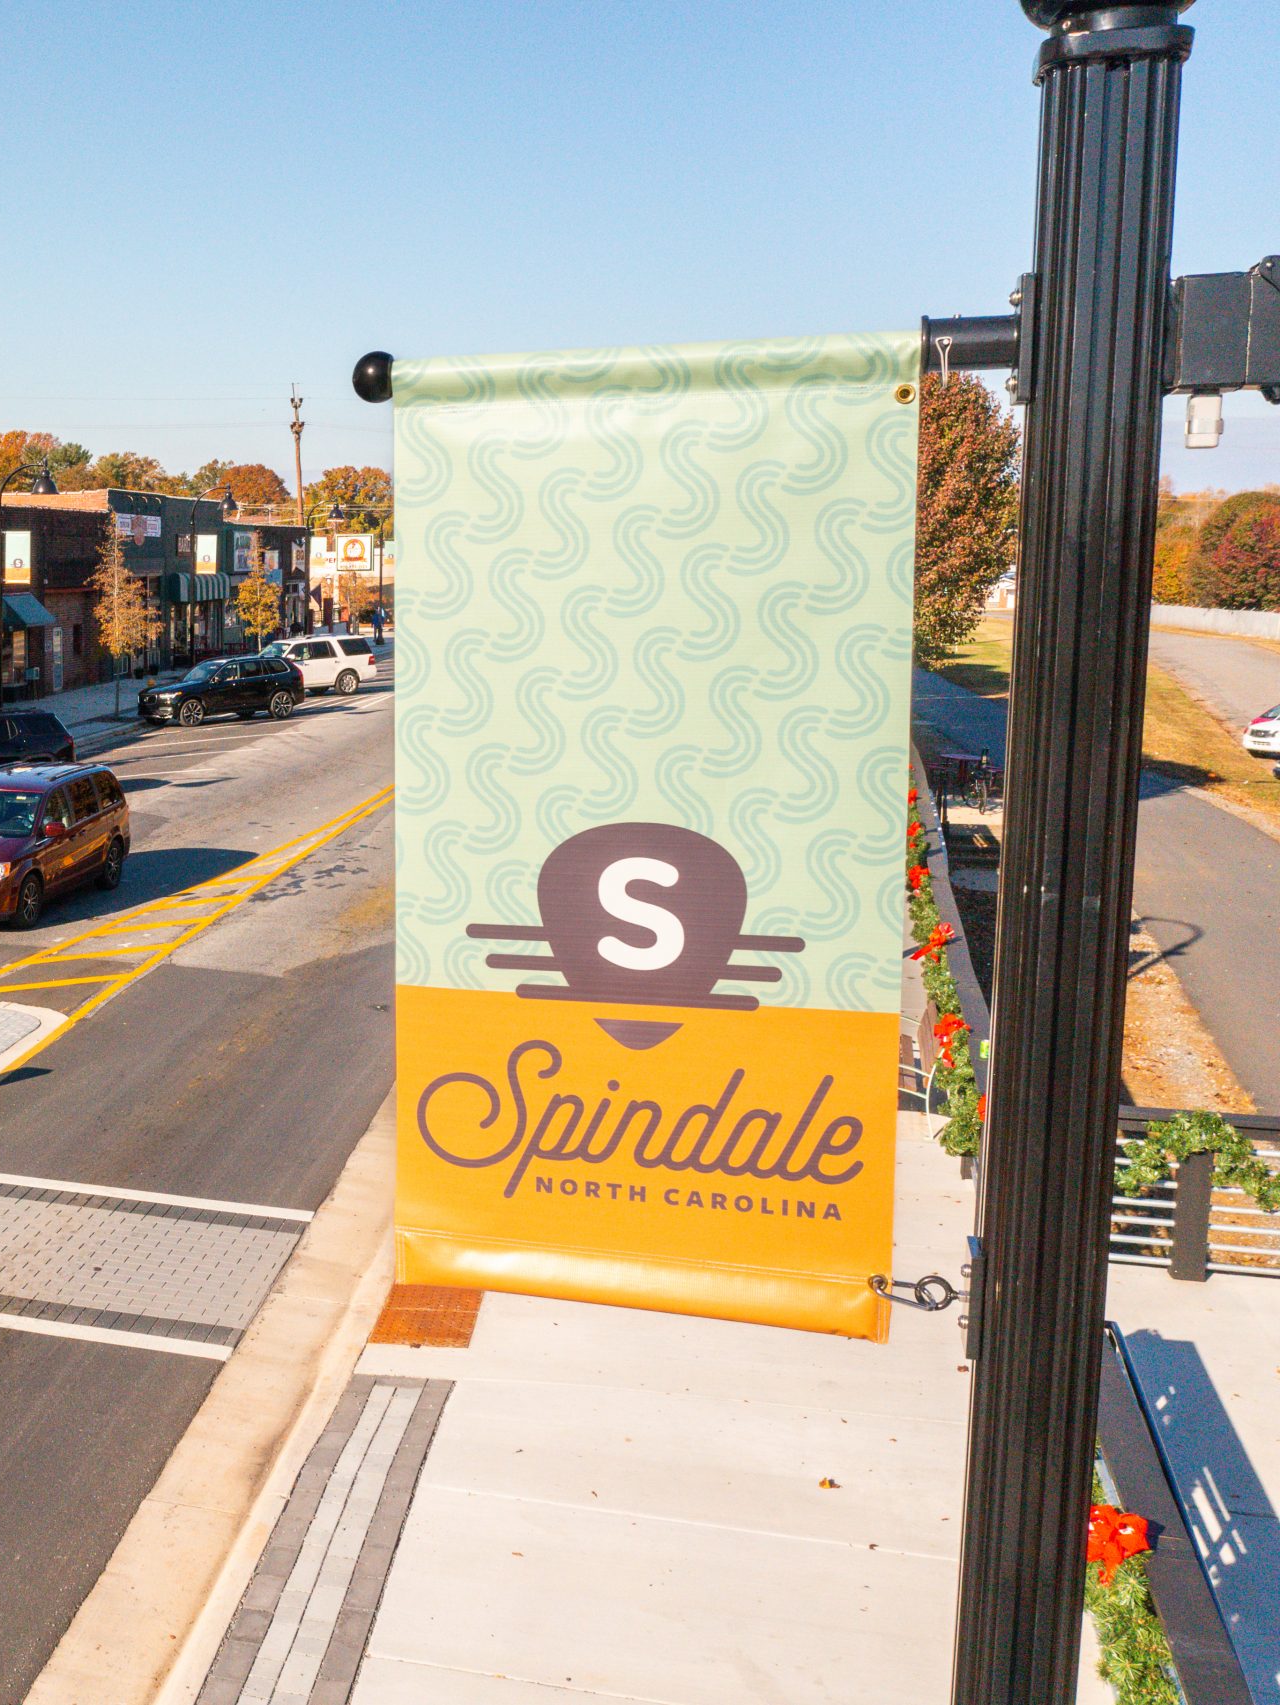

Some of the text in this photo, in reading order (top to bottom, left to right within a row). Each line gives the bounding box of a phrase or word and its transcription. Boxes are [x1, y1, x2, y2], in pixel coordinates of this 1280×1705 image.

[596, 855, 686, 971] S
[416, 1039, 864, 1199] Spindale
[535, 1175, 842, 1221] NORTH CAROLINA
